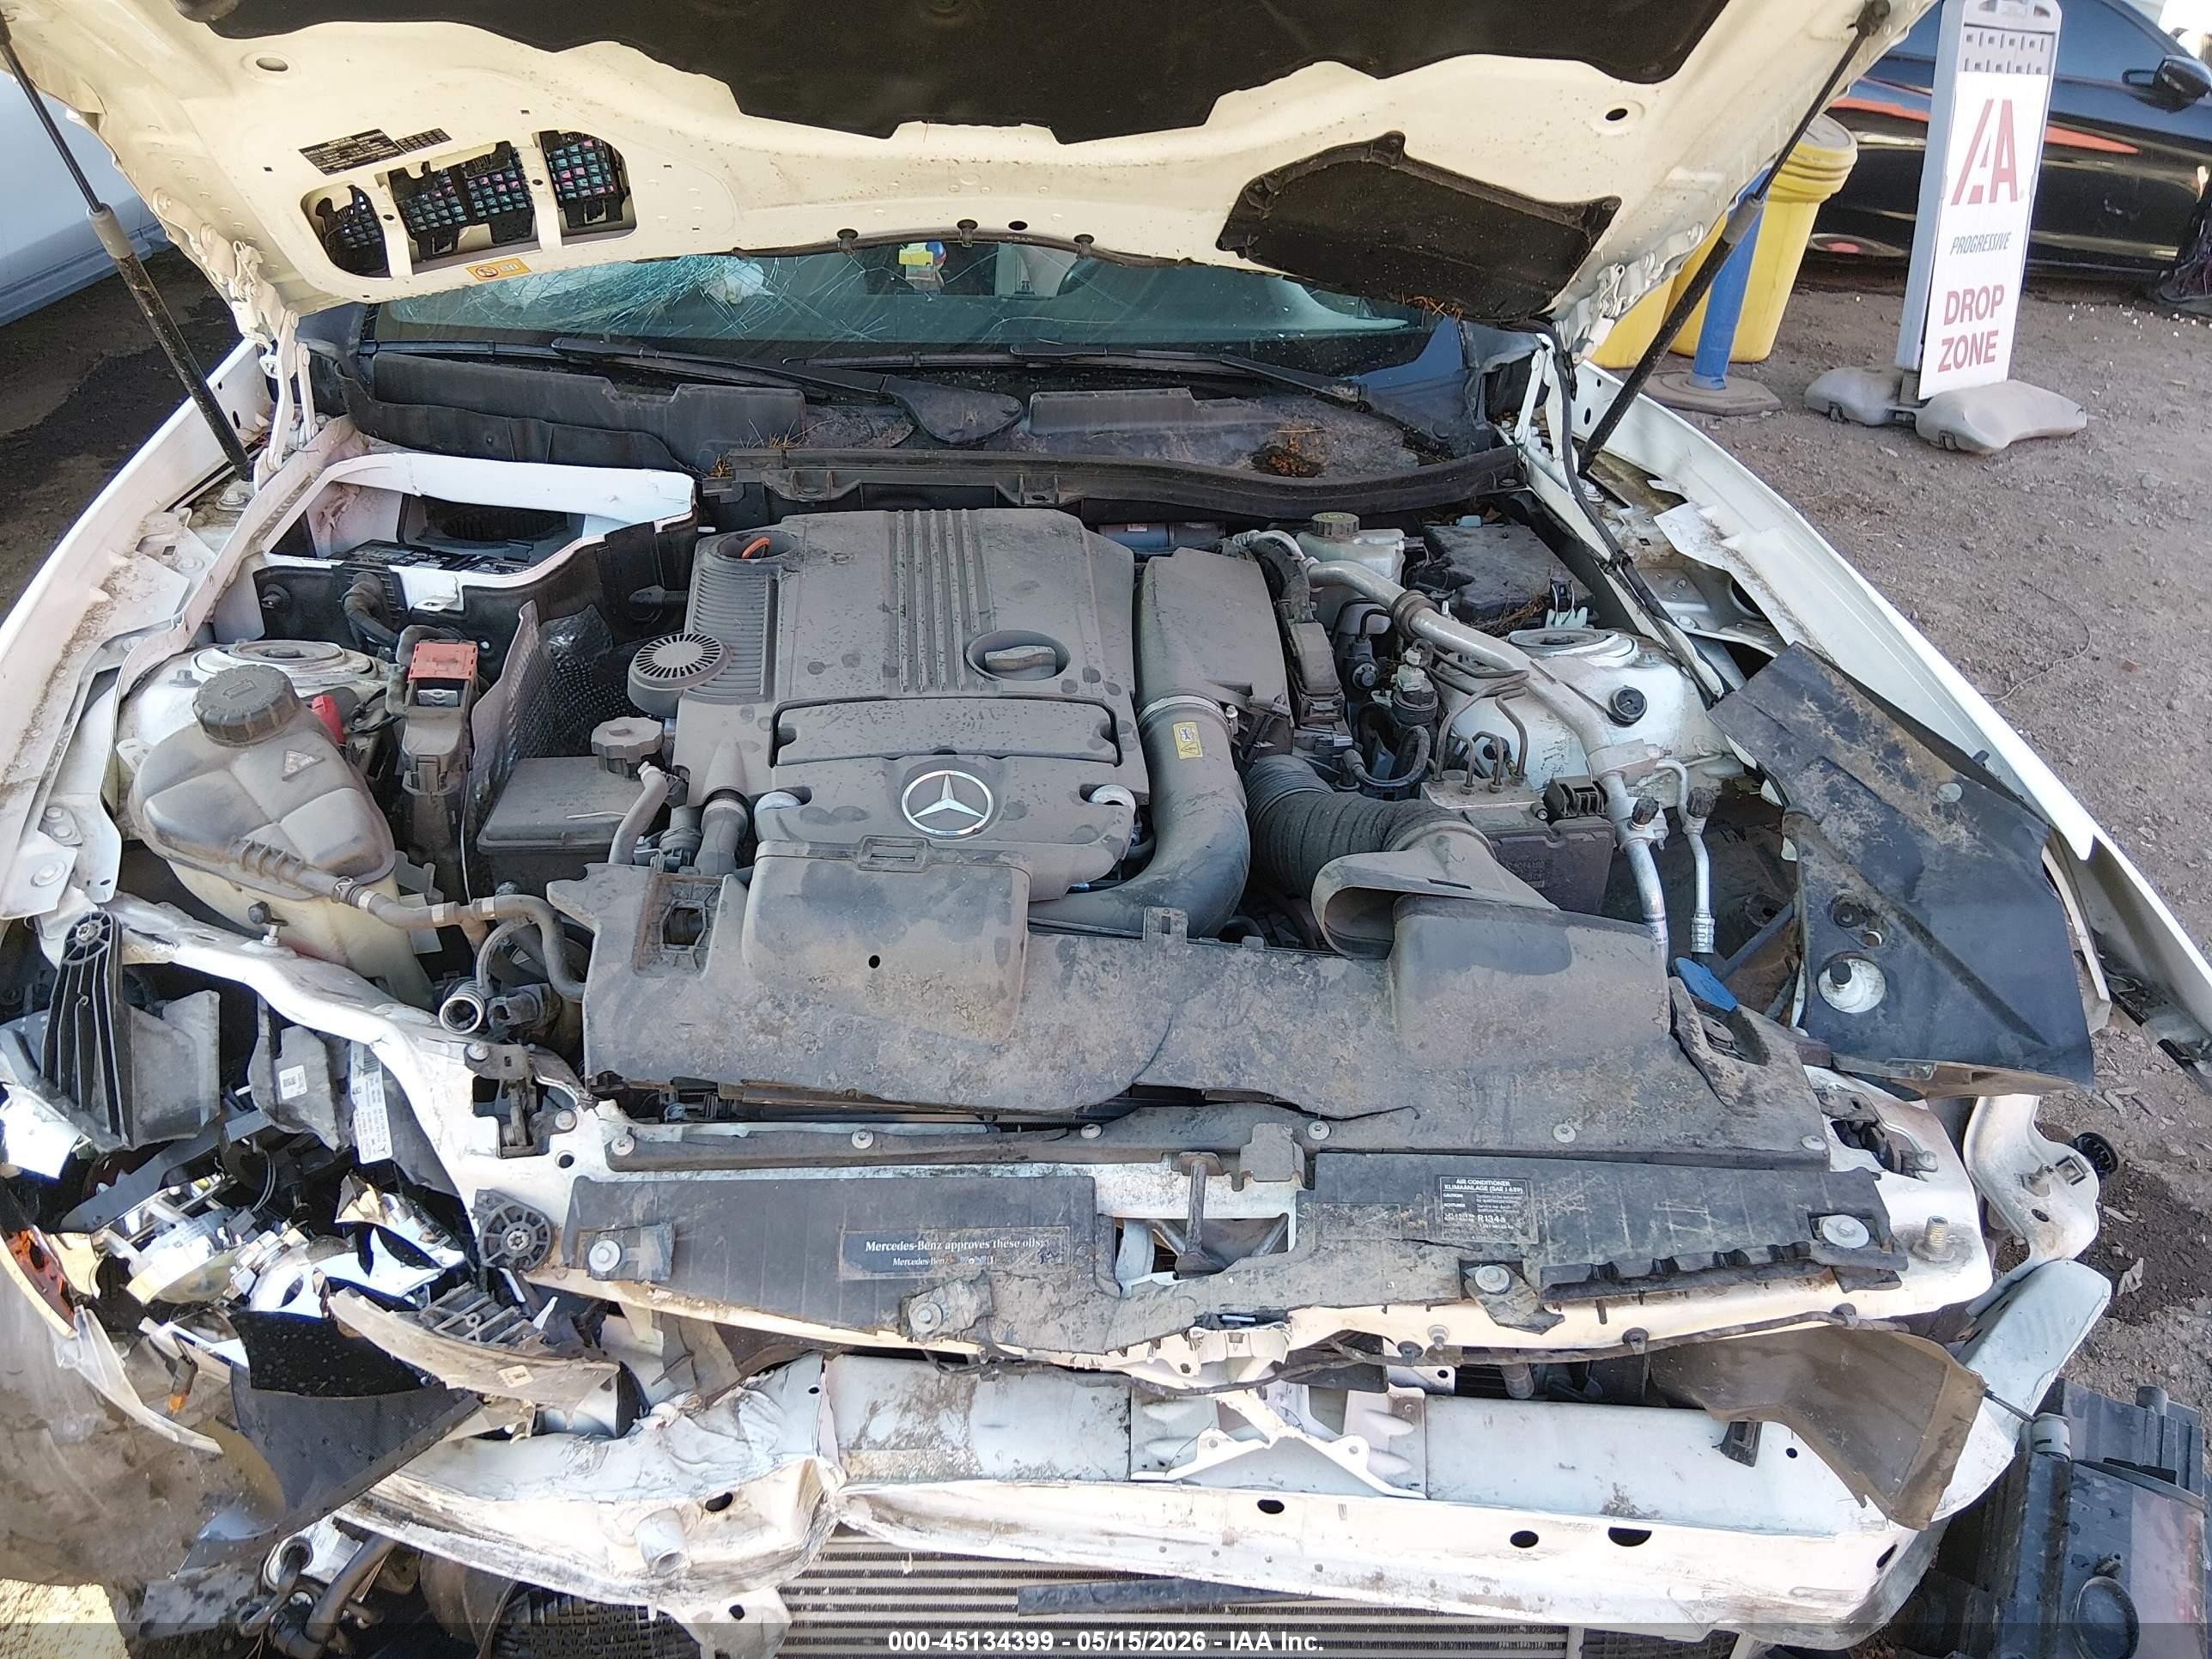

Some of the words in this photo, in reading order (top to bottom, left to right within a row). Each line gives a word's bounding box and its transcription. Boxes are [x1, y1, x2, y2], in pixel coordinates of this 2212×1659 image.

[1949, 231, 2012, 256] PROGRESSIVE
[1943, 284, 2004, 326] DROP
[1937, 330, 1999, 373] ZONE
[1477, 1214, 1506, 1224] R134a
[865, 1240, 944, 1253] Mercedes-Benz
[945, 1240, 990, 1253] approves
[992, 1238, 1021, 1249] these
